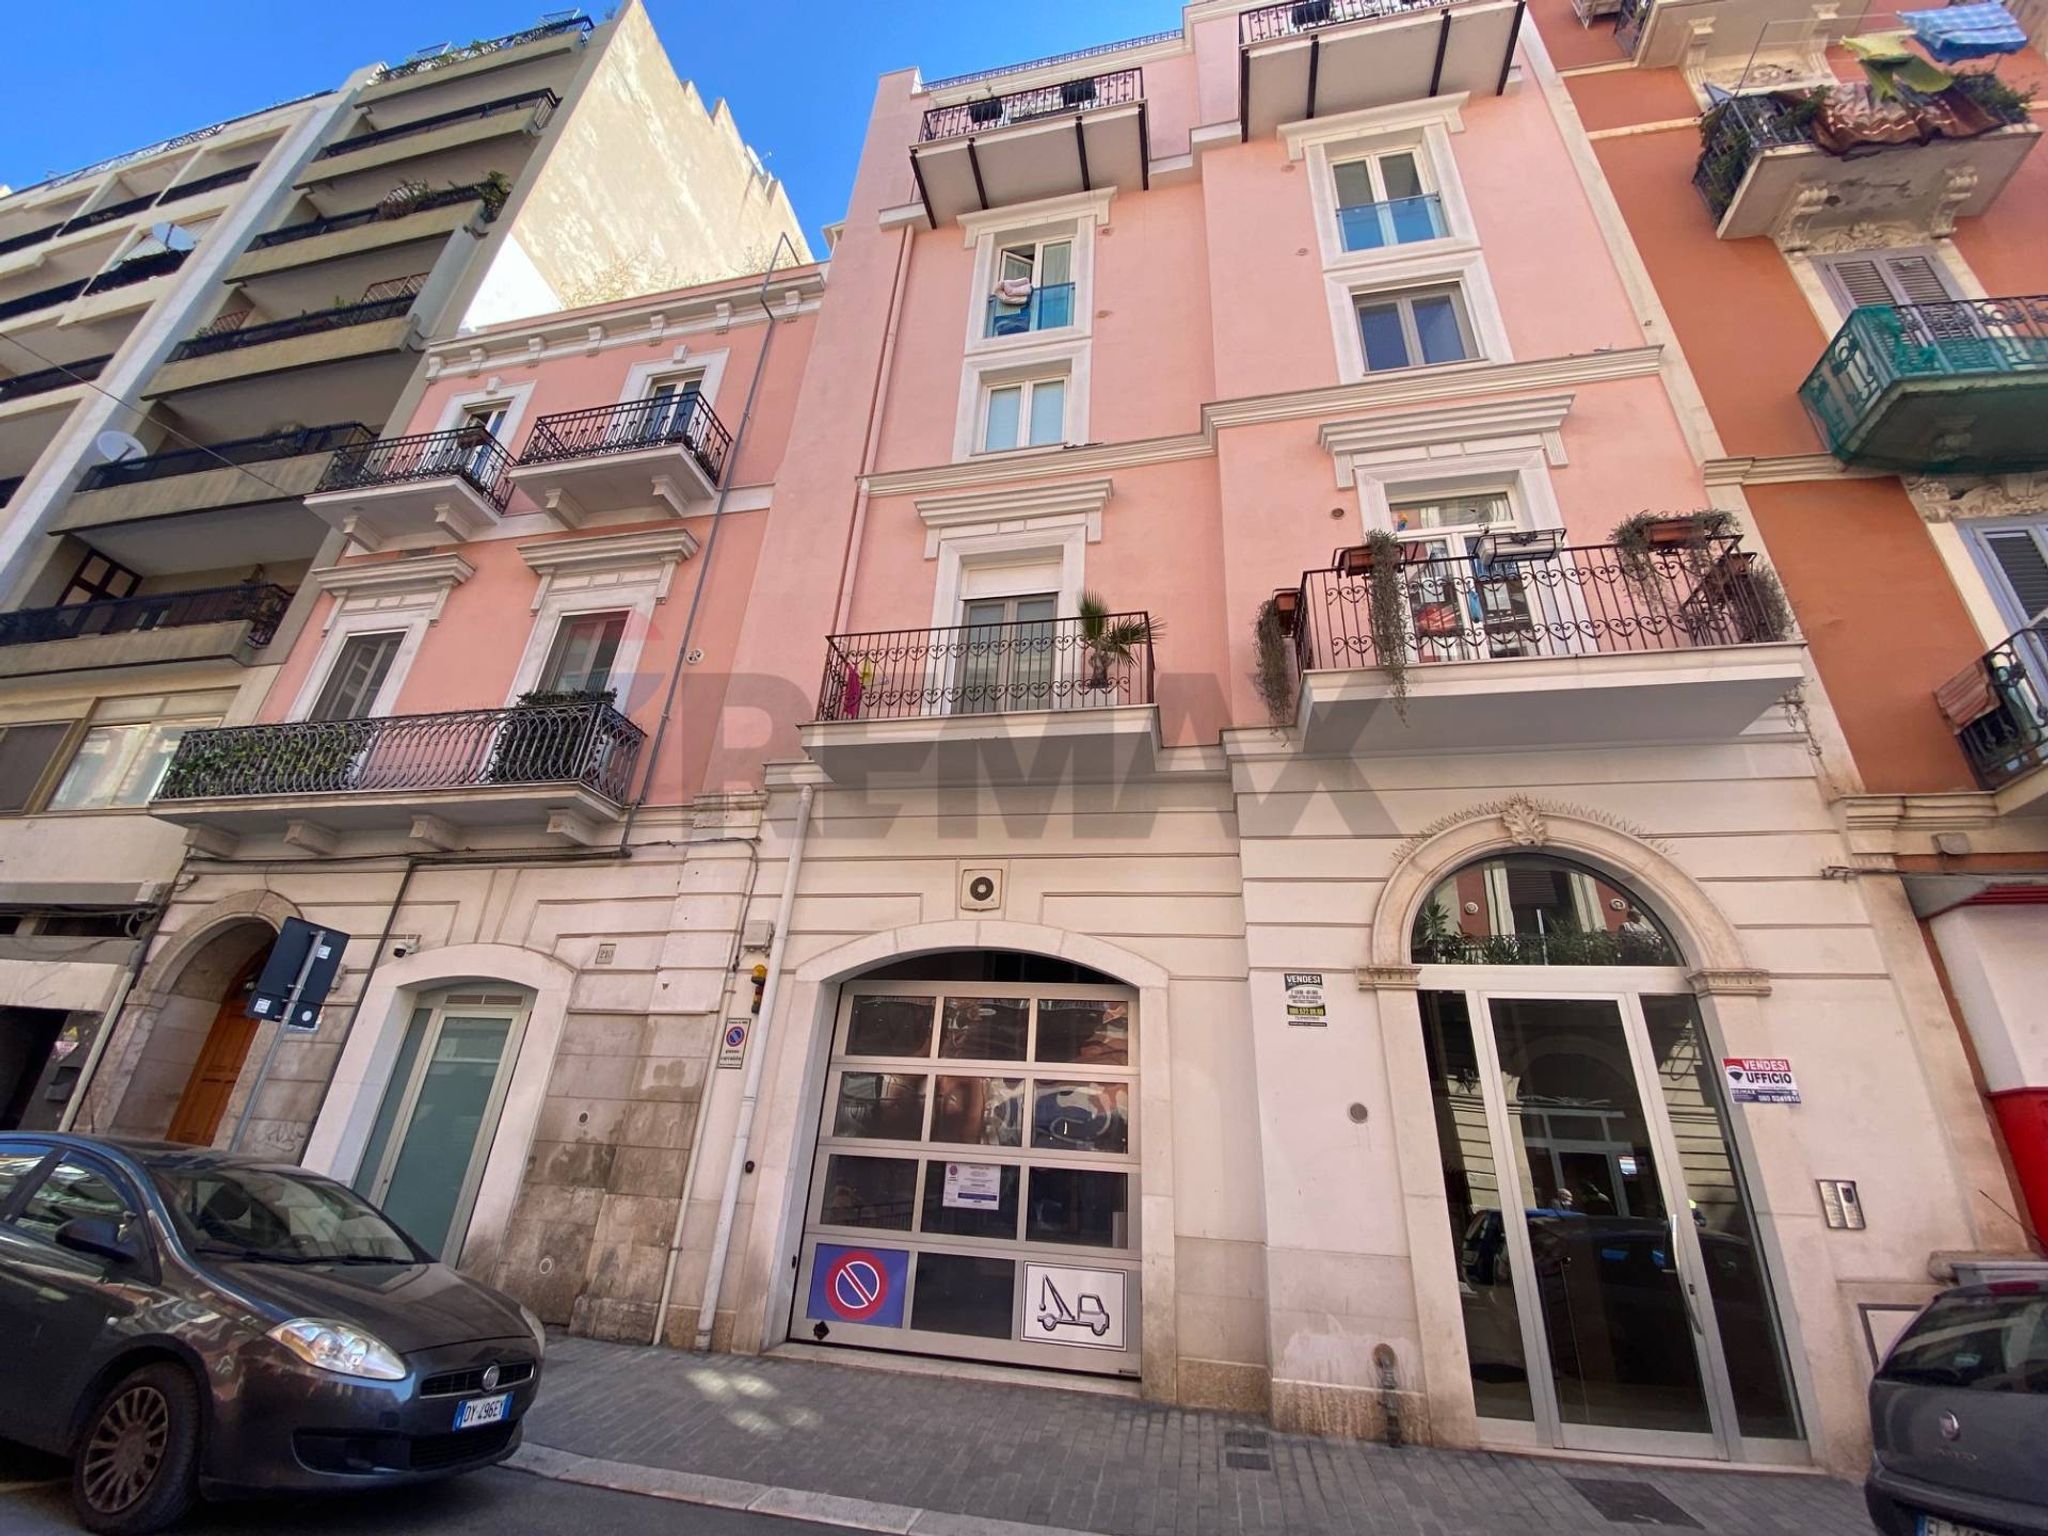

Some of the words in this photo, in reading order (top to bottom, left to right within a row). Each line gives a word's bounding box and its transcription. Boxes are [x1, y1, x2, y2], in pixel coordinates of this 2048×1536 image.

[1286, 975, 1321, 983] VENDESI
[1741, 1059, 1788, 1071] VENDESI
[1746, 1072, 1792, 1084] UFFICIO
